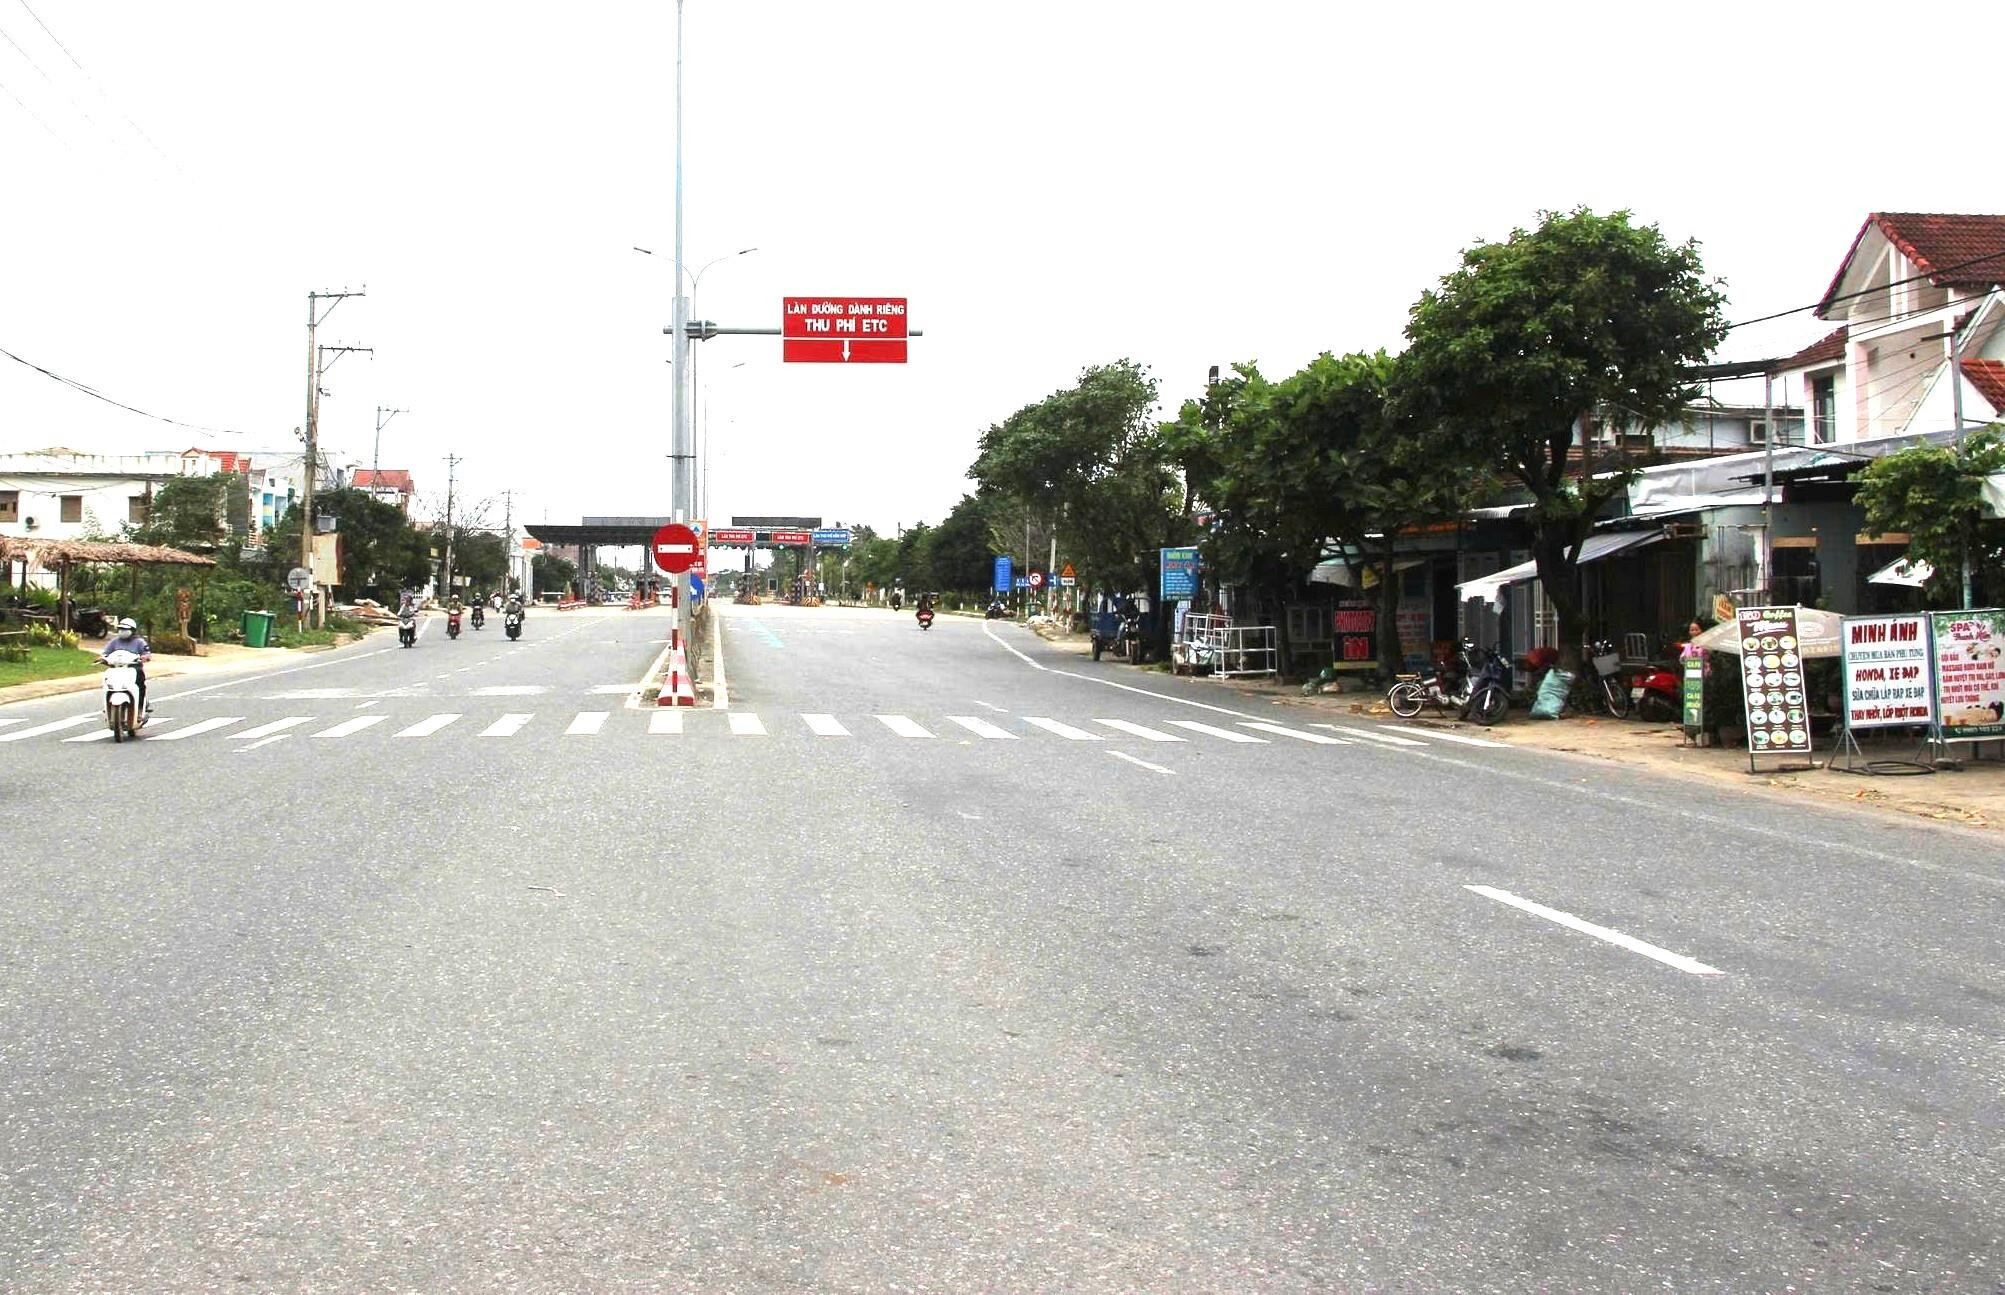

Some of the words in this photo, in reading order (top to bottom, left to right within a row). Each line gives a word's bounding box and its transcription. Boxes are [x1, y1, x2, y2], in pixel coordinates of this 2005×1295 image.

[788, 302, 807, 314] LÀN
[848, 302, 872, 315] DÀNH
[877, 302, 904, 315] RIÊNG
[805, 318, 830, 332] THU
[836, 316, 856, 332] PHÍ
[863, 318, 888, 332] ETC
[1852, 624, 1886, 644] MINH
[1951, 623, 1970, 632] SPA
[1889, 667, 1900, 680] XE
